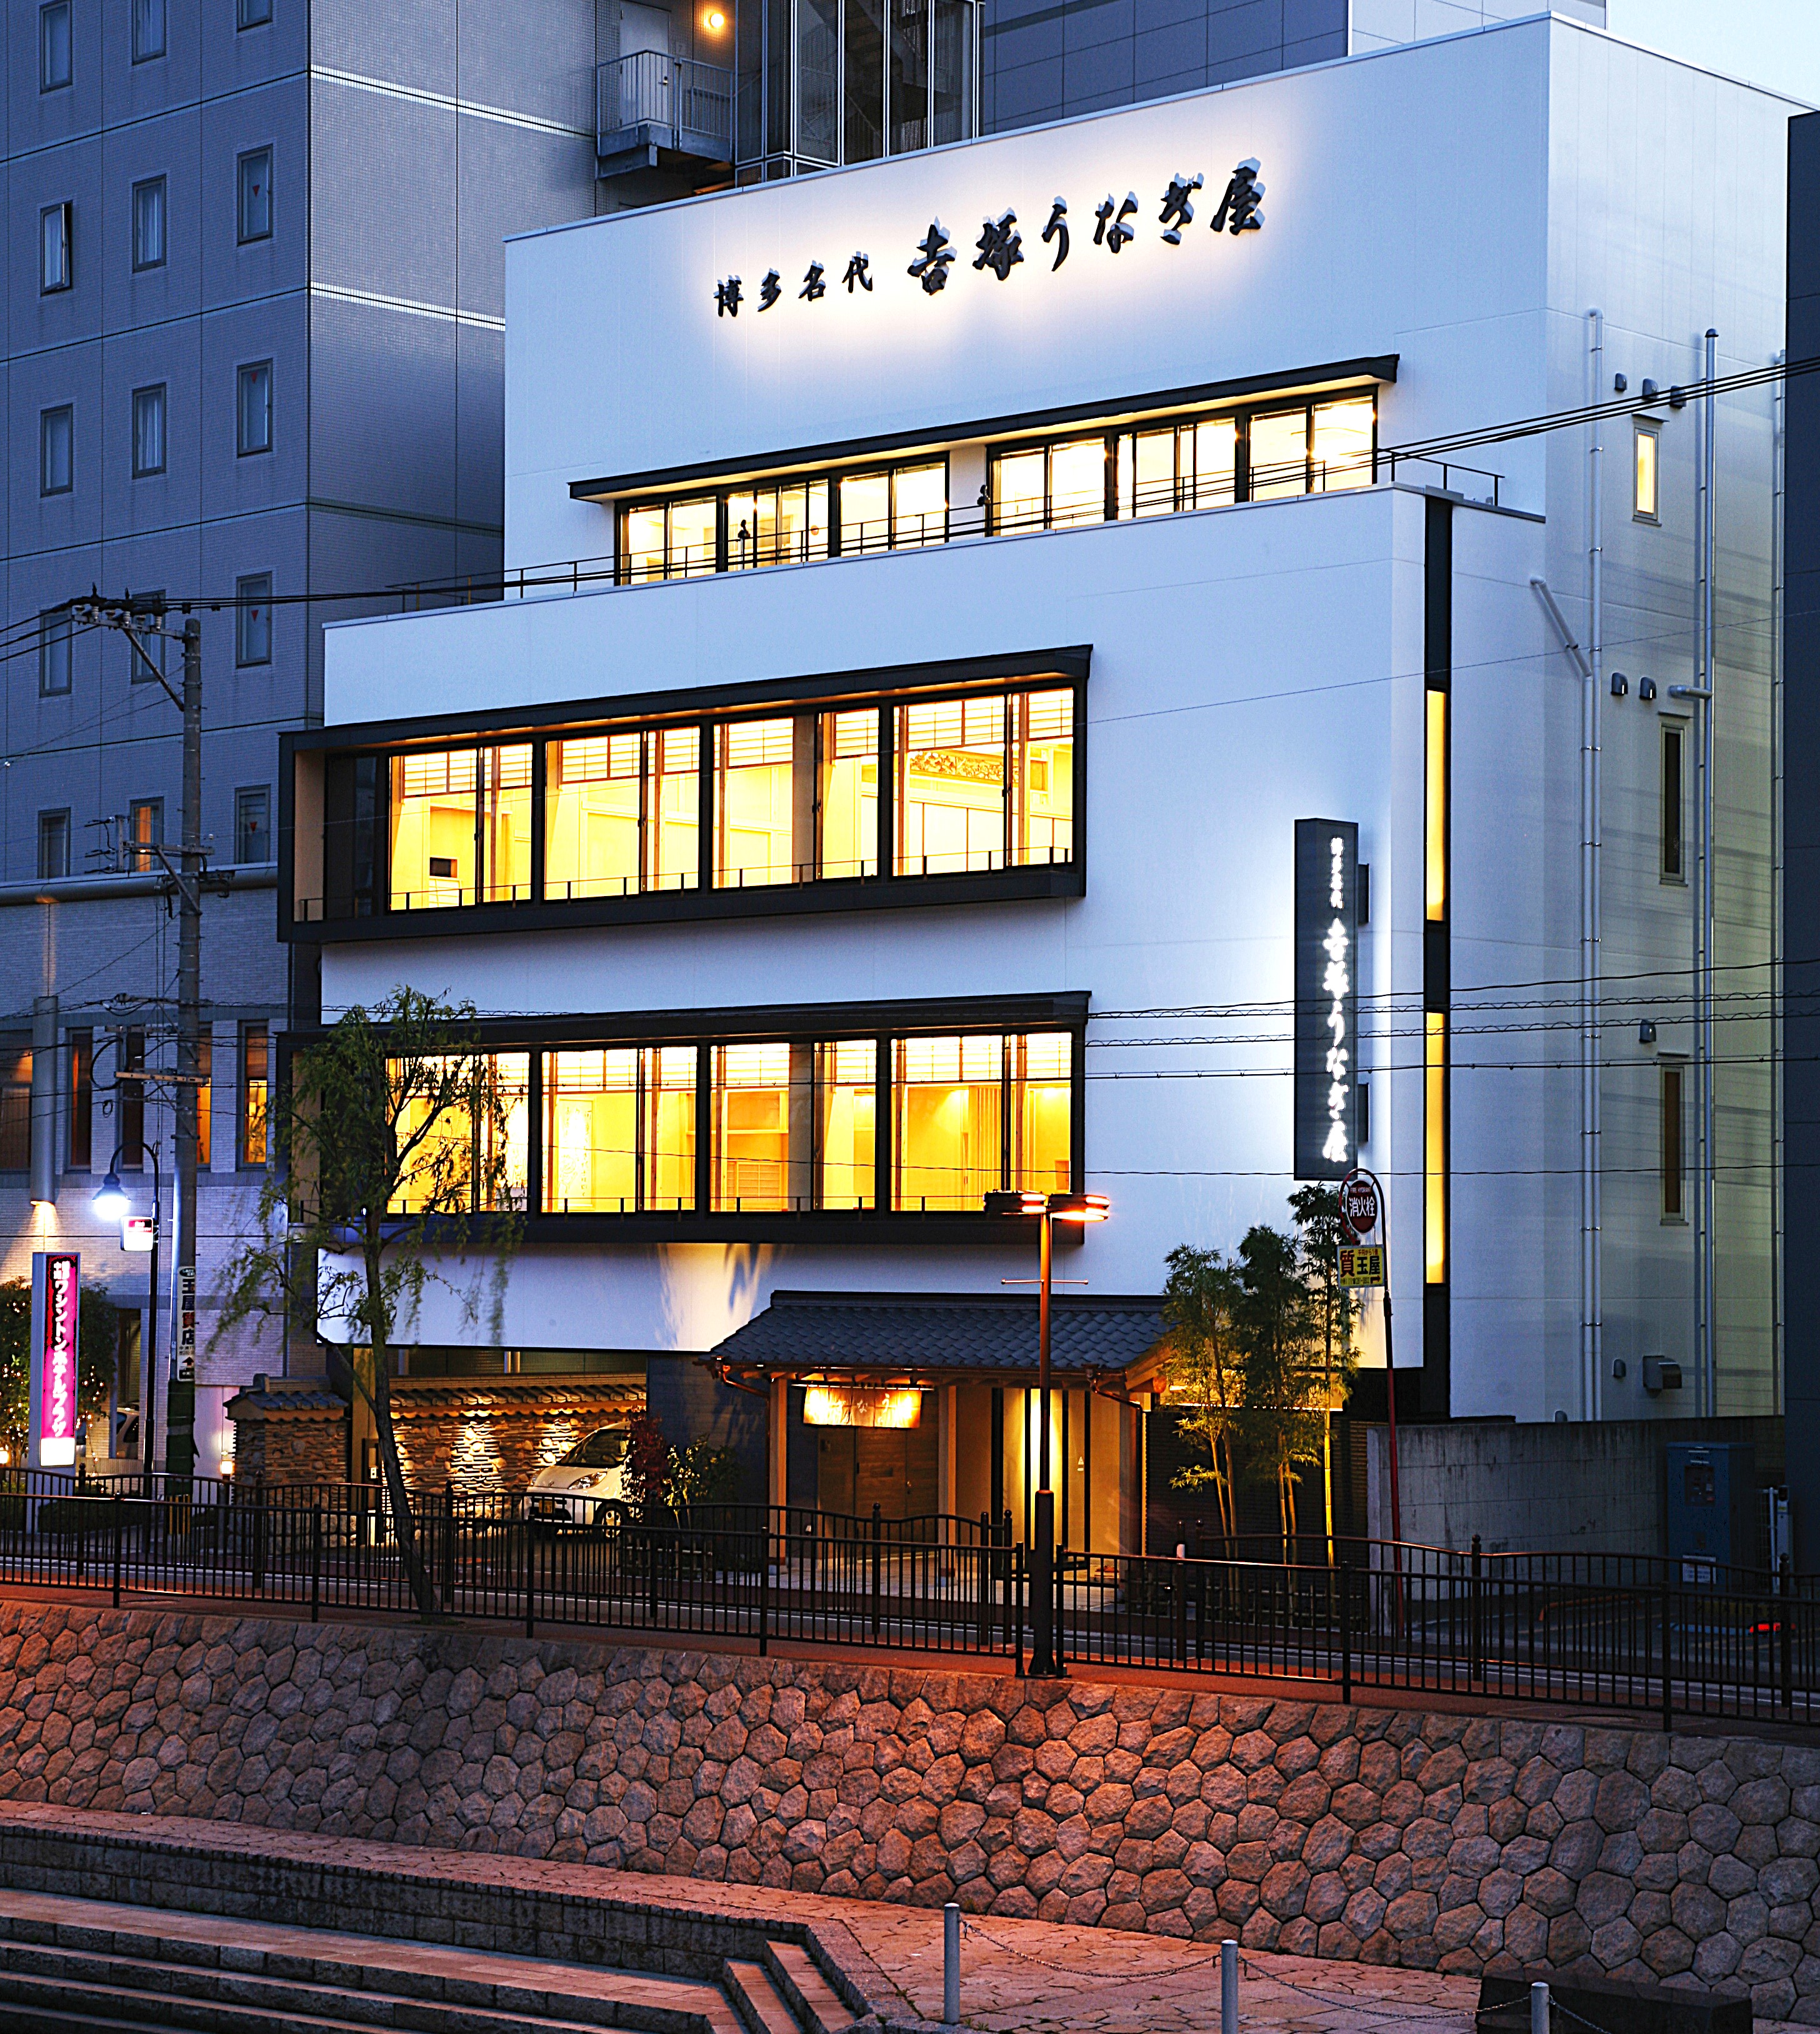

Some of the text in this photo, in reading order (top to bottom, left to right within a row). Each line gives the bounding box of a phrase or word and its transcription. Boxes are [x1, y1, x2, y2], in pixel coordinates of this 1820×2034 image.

[713, 156, 1266, 317] 博多名代 吉塚うなぎ屋
[1349, 1196, 1376, 1217] 消火栓
[1340, 1249, 1355, 1278] 質
[1357, 1255, 1381, 1275] 玉屋
